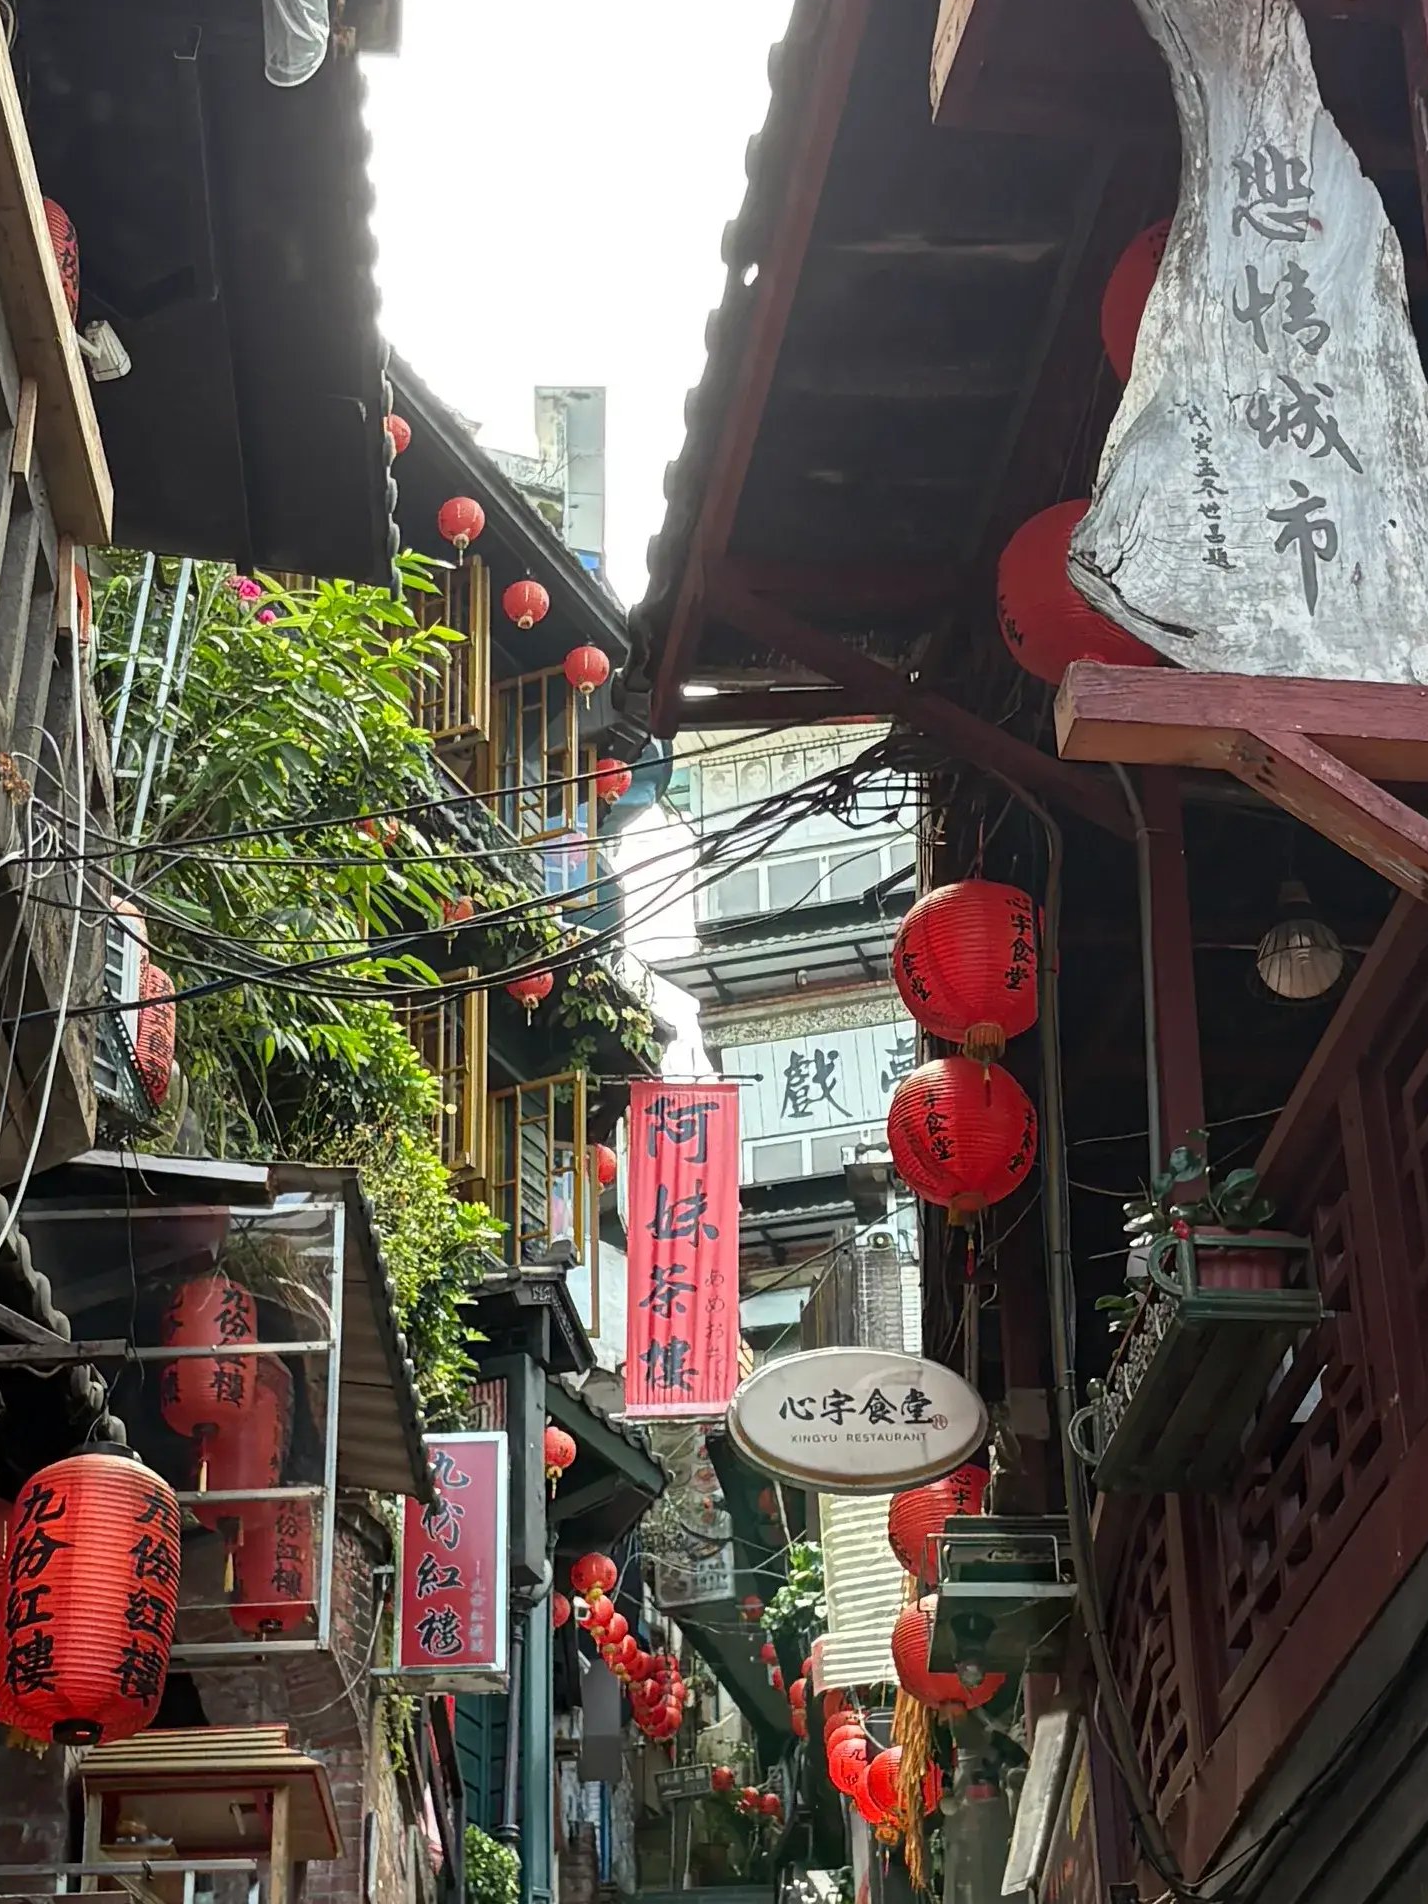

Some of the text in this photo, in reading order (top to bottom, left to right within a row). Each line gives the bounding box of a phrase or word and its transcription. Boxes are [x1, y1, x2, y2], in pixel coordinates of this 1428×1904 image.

[1230, 144, 1364, 617] 悲情城市
[637, 1094, 721, 1393] 阿妹茶樓
[790, 1431, 928, 1444] XINGYU RESTAURANT
